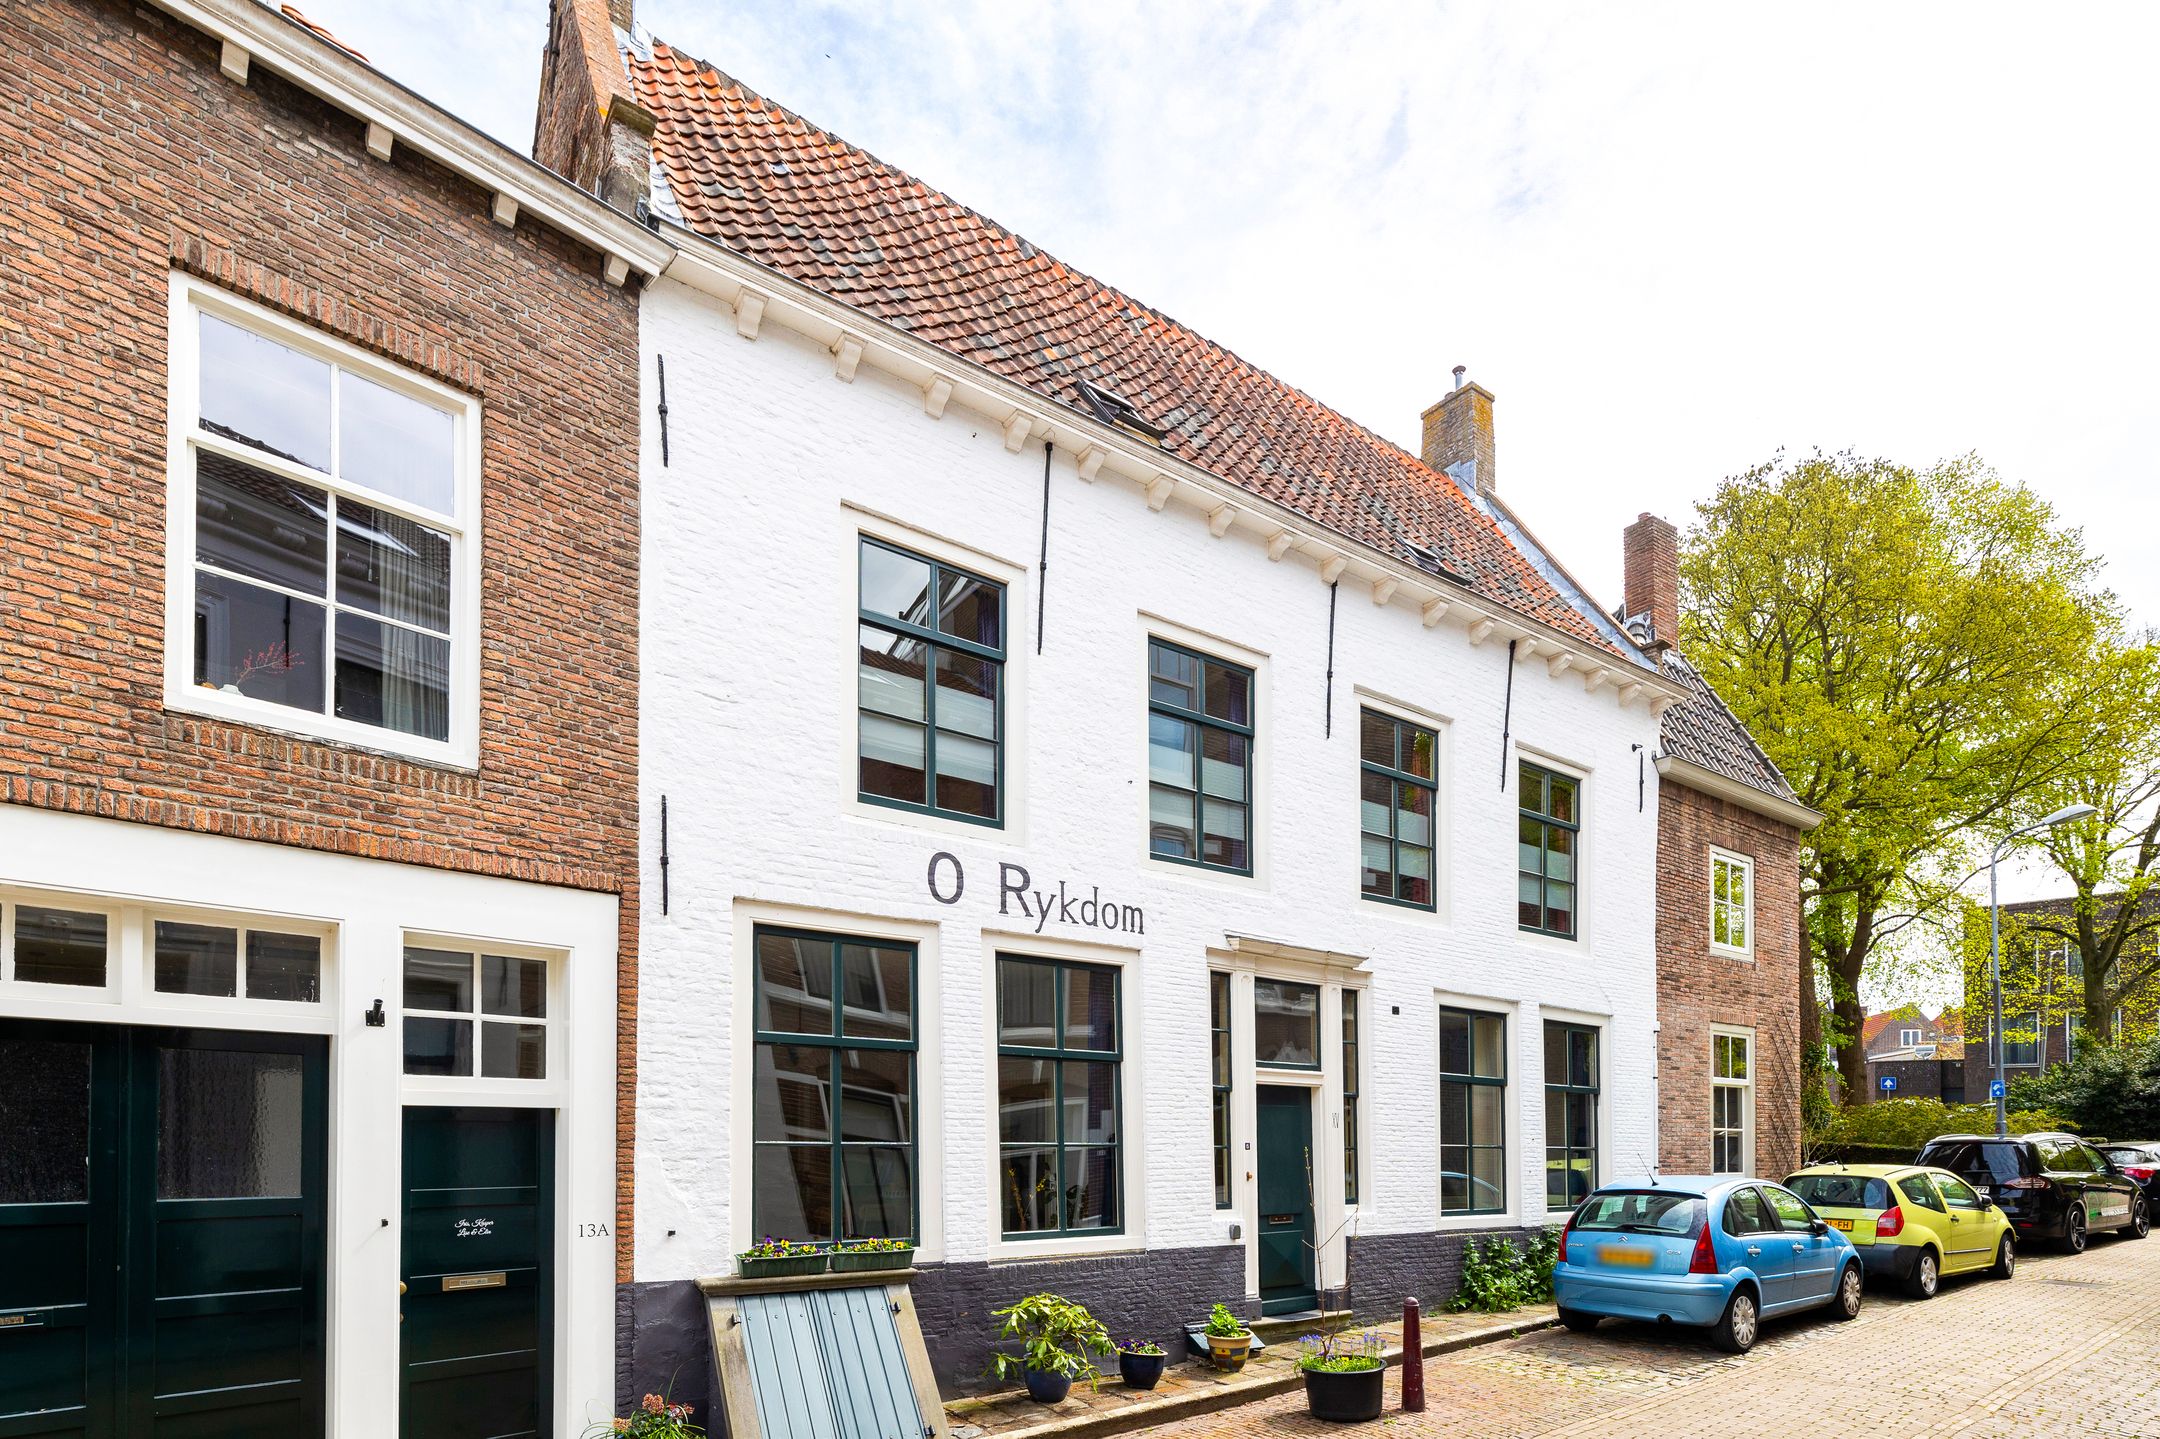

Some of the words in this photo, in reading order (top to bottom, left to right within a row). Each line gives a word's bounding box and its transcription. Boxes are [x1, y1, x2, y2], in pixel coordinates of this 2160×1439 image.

[927, 851, 964, 905] O
[998, 861, 1145, 934] Rykdom
[579, 1223, 610, 1238] 13A
